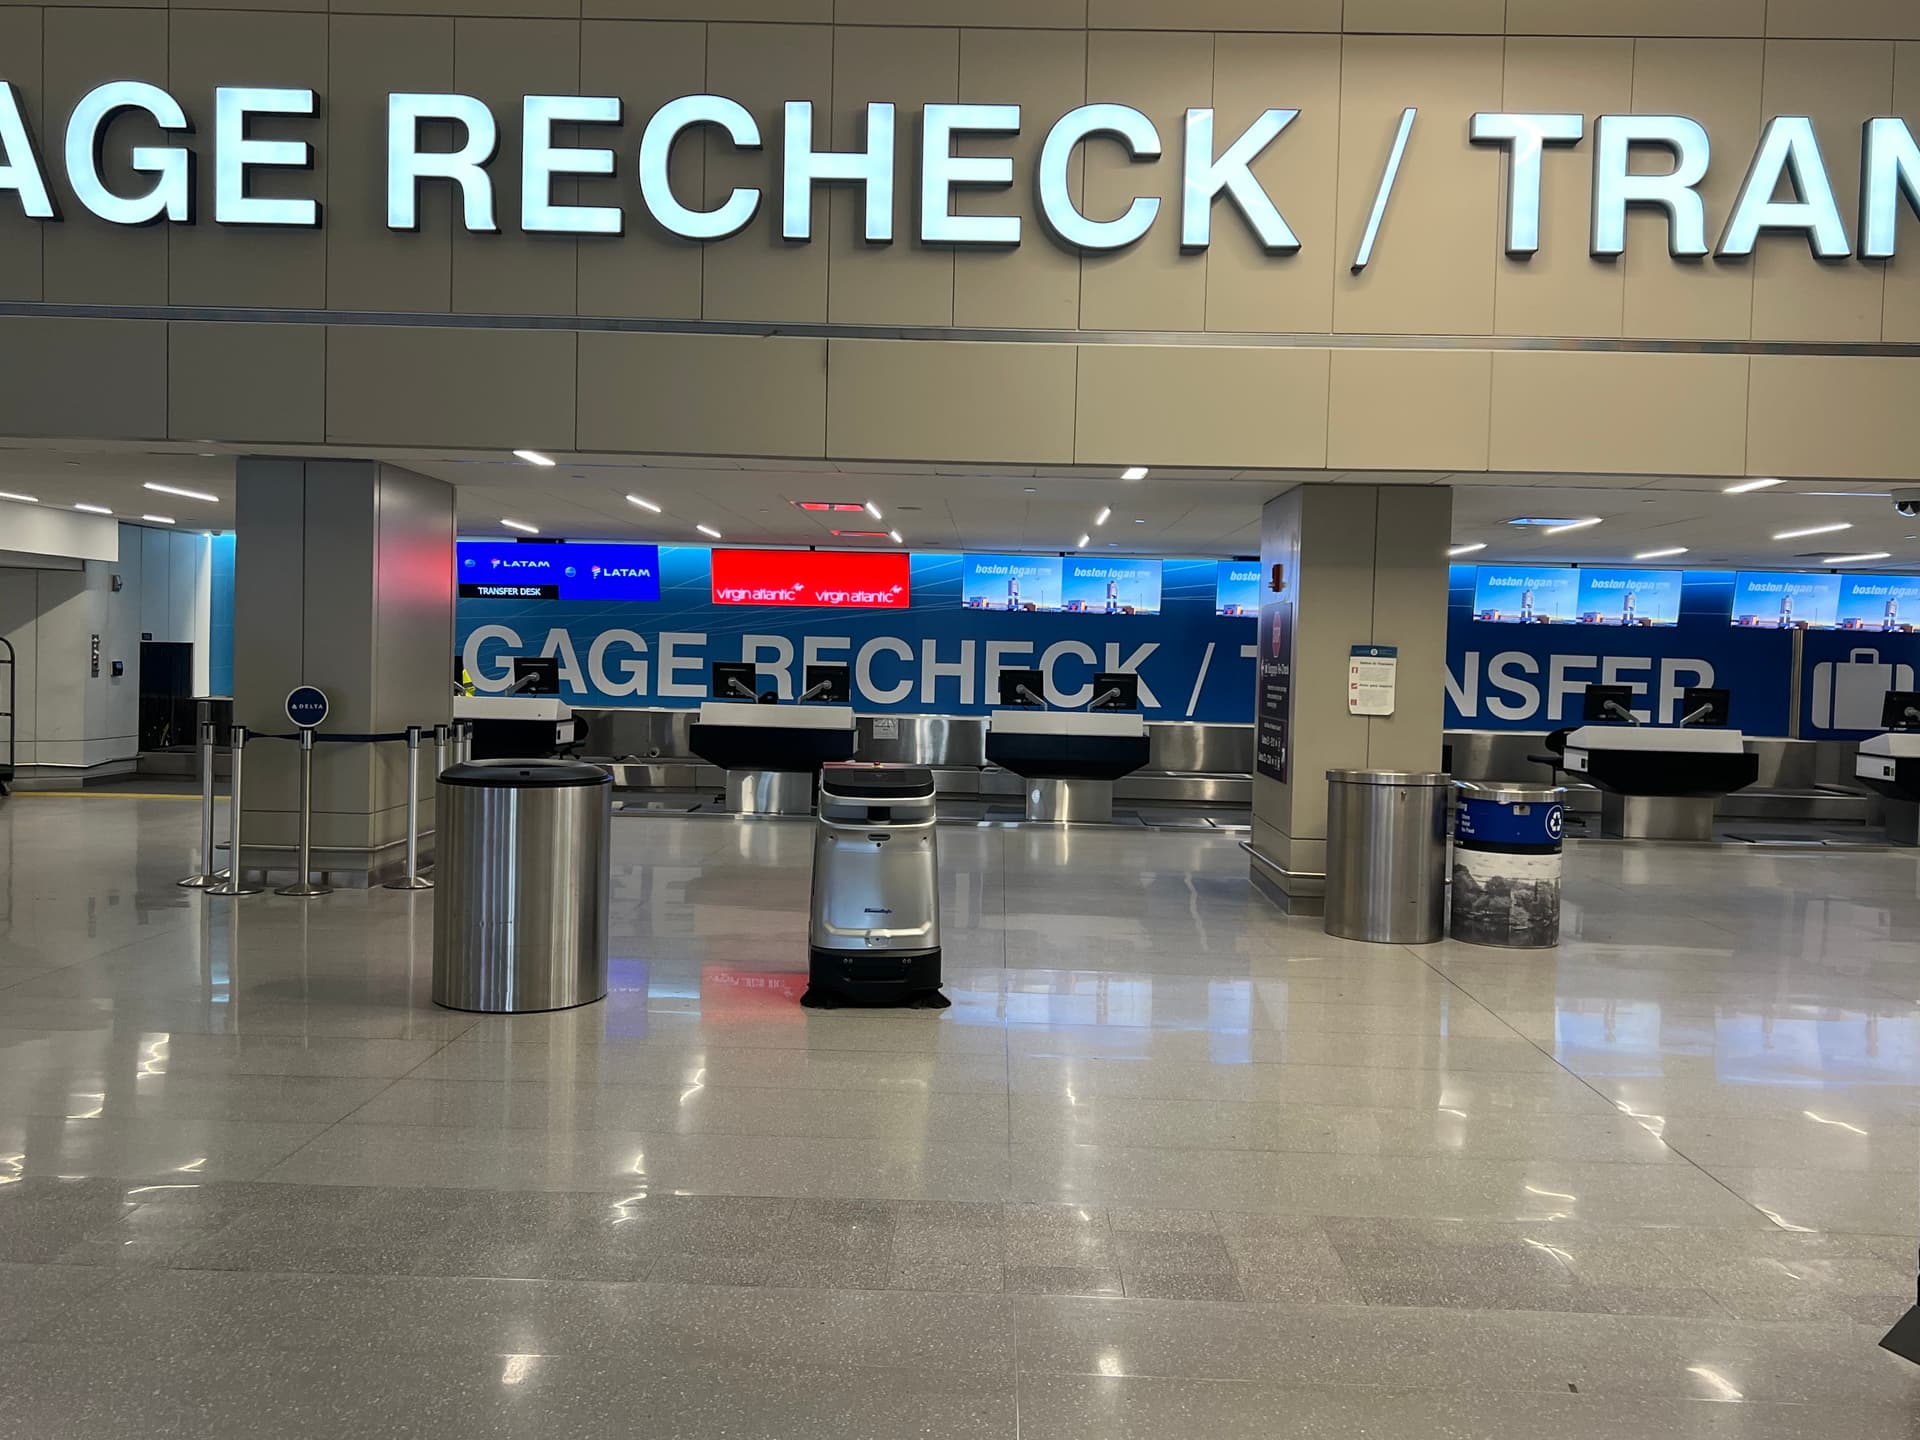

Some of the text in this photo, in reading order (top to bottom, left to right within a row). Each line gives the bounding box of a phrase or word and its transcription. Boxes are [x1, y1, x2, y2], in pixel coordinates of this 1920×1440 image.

[386, 92, 1301, 256] RECHECK
[1350, 106, 1418, 275] /
[503, 559, 550, 568] LATAM
[603, 567, 651, 577] LATAM
[975, 564, 1007, 575] boston
[1008, 565, 1037, 578] logan
[1074, 567, 1106, 578] boston
[1107, 568, 1136, 580] logan
[1489, 576, 1522, 587] boston
[1523, 577, 1552, 590] logan
[1591, 579, 1624, 590] boston
[1625, 579, 1655, 592] logan
[1748, 582, 1782, 593] boston
[1783, 583, 1813, 595] logan
[478, 586, 541, 596] TRANSFER DESK
[717, 587, 796, 602] virgin atlantic
[815, 590, 894, 605] virgin atlantic
[1852, 585, 1918, 598] boston logan
[463, 624, 708, 698] GAGE
[1185, 642, 1215, 717] /
